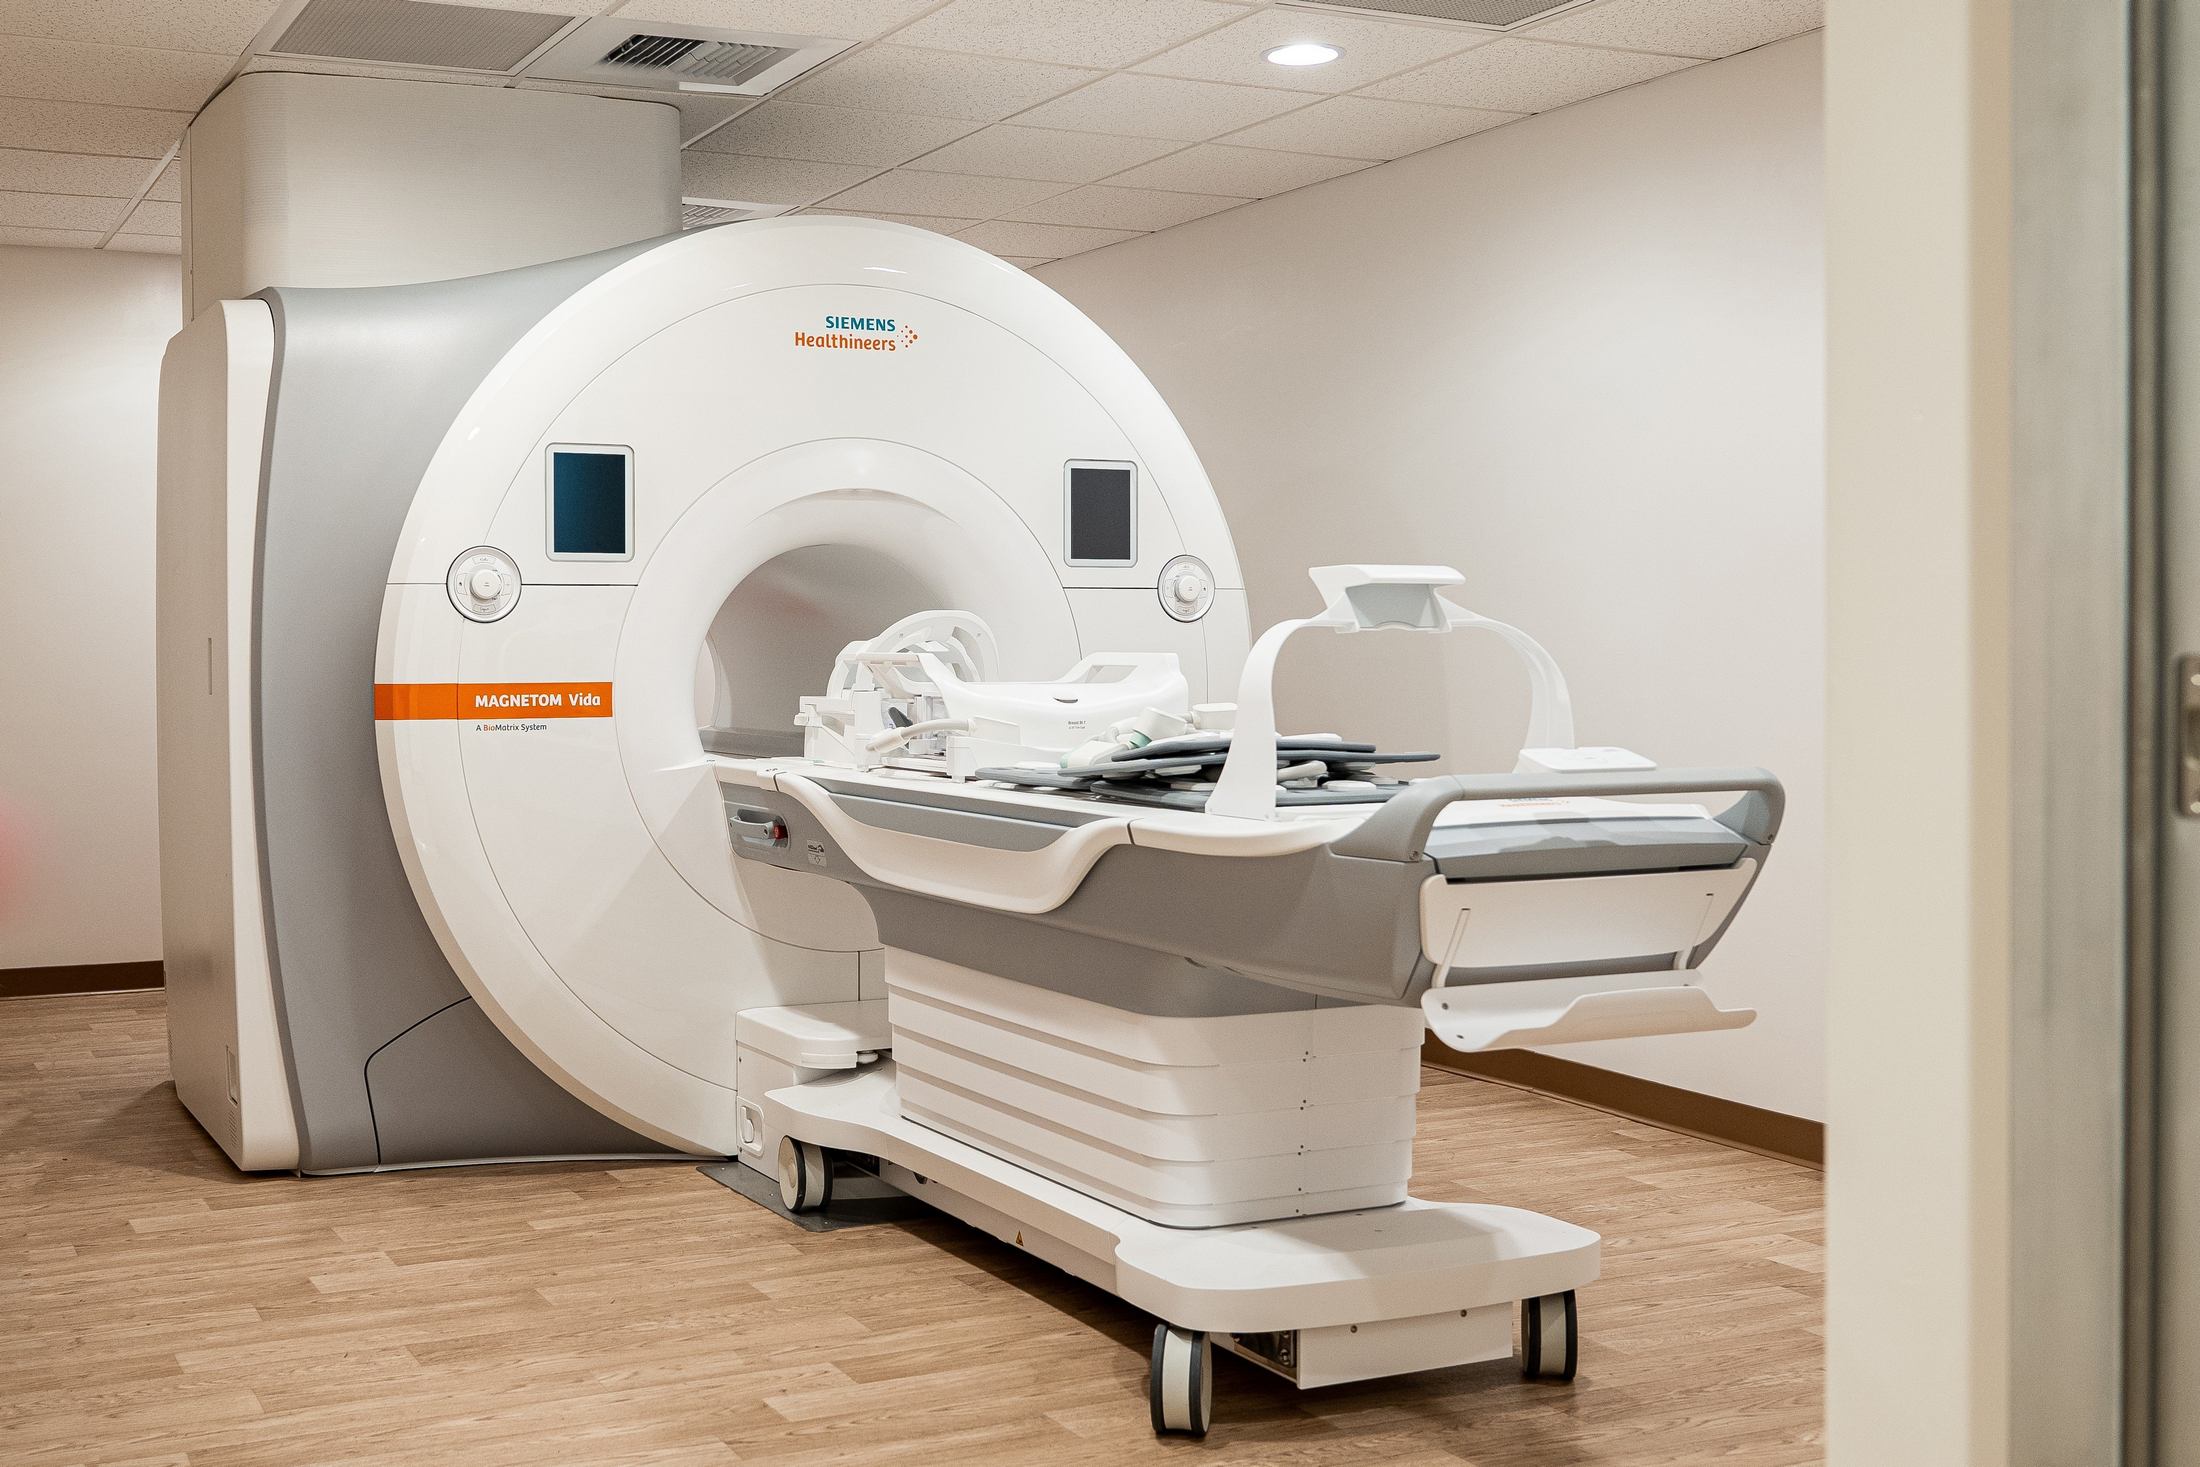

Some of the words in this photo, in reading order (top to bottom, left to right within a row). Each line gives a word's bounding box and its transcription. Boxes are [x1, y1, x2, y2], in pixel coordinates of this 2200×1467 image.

[825, 315, 896, 332] SIEMENS
[794, 331, 896, 351] Healthineers
[475, 693, 562, 708] MAGNETOM
[568, 692, 601, 706] Vida
[475, 724, 482, 732] A
[483, 723, 520, 732] BioMatrix
[520, 723, 547, 733] System
